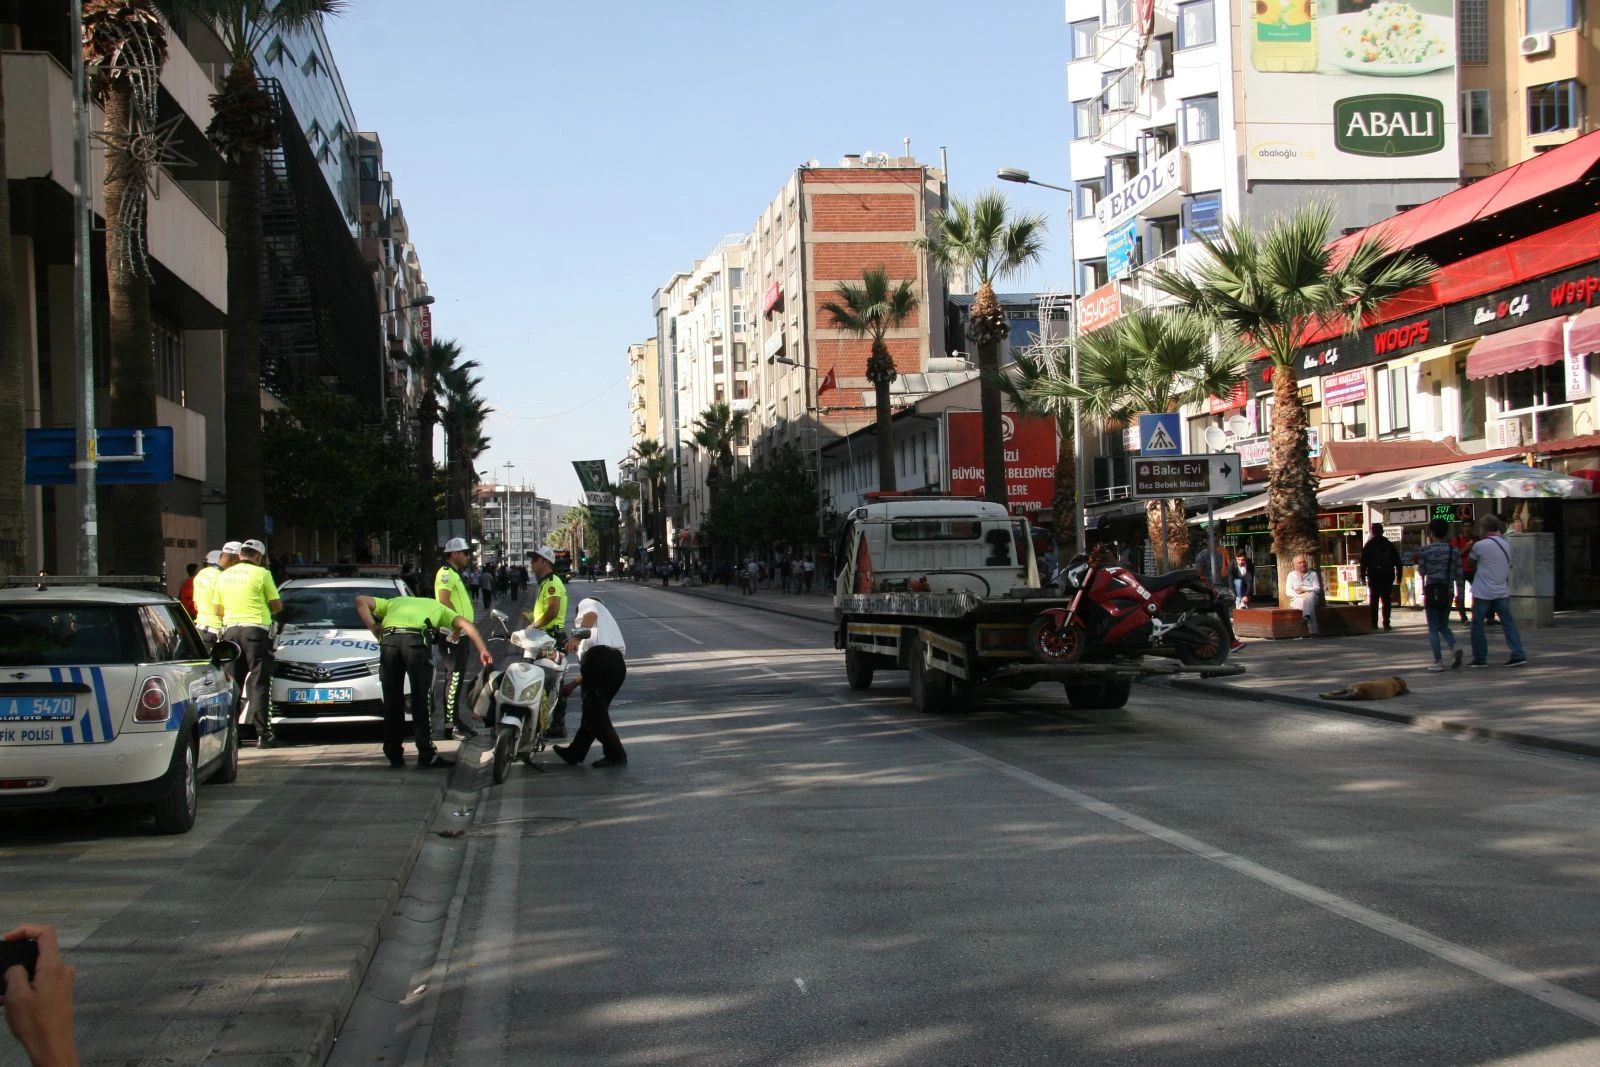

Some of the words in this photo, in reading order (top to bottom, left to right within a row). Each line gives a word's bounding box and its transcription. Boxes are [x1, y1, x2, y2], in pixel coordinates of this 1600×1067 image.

[1345, 111, 1434, 137] ABALI
[1111, 166, 1164, 219] EKOL
[1374, 319, 1430, 355] WOOPS
[1003, 448, 1019, 462] İZLİ
[1152, 465, 1180, 476] Balcı
[1183, 464, 1201, 475] Evi
[1139, 482, 1153, 490] Bez
[1154, 481, 1178, 489] Bebek
[295, 690, 306, 701] 20
[313, 690, 320, 701] A
[328, 689, 350, 700] 5434
[9, 699, 19, 715] A
[33, 698, 71, 715] 5470
[0, 728, 16, 741] FİK
[21, 726, 54, 741] POLİSİ
